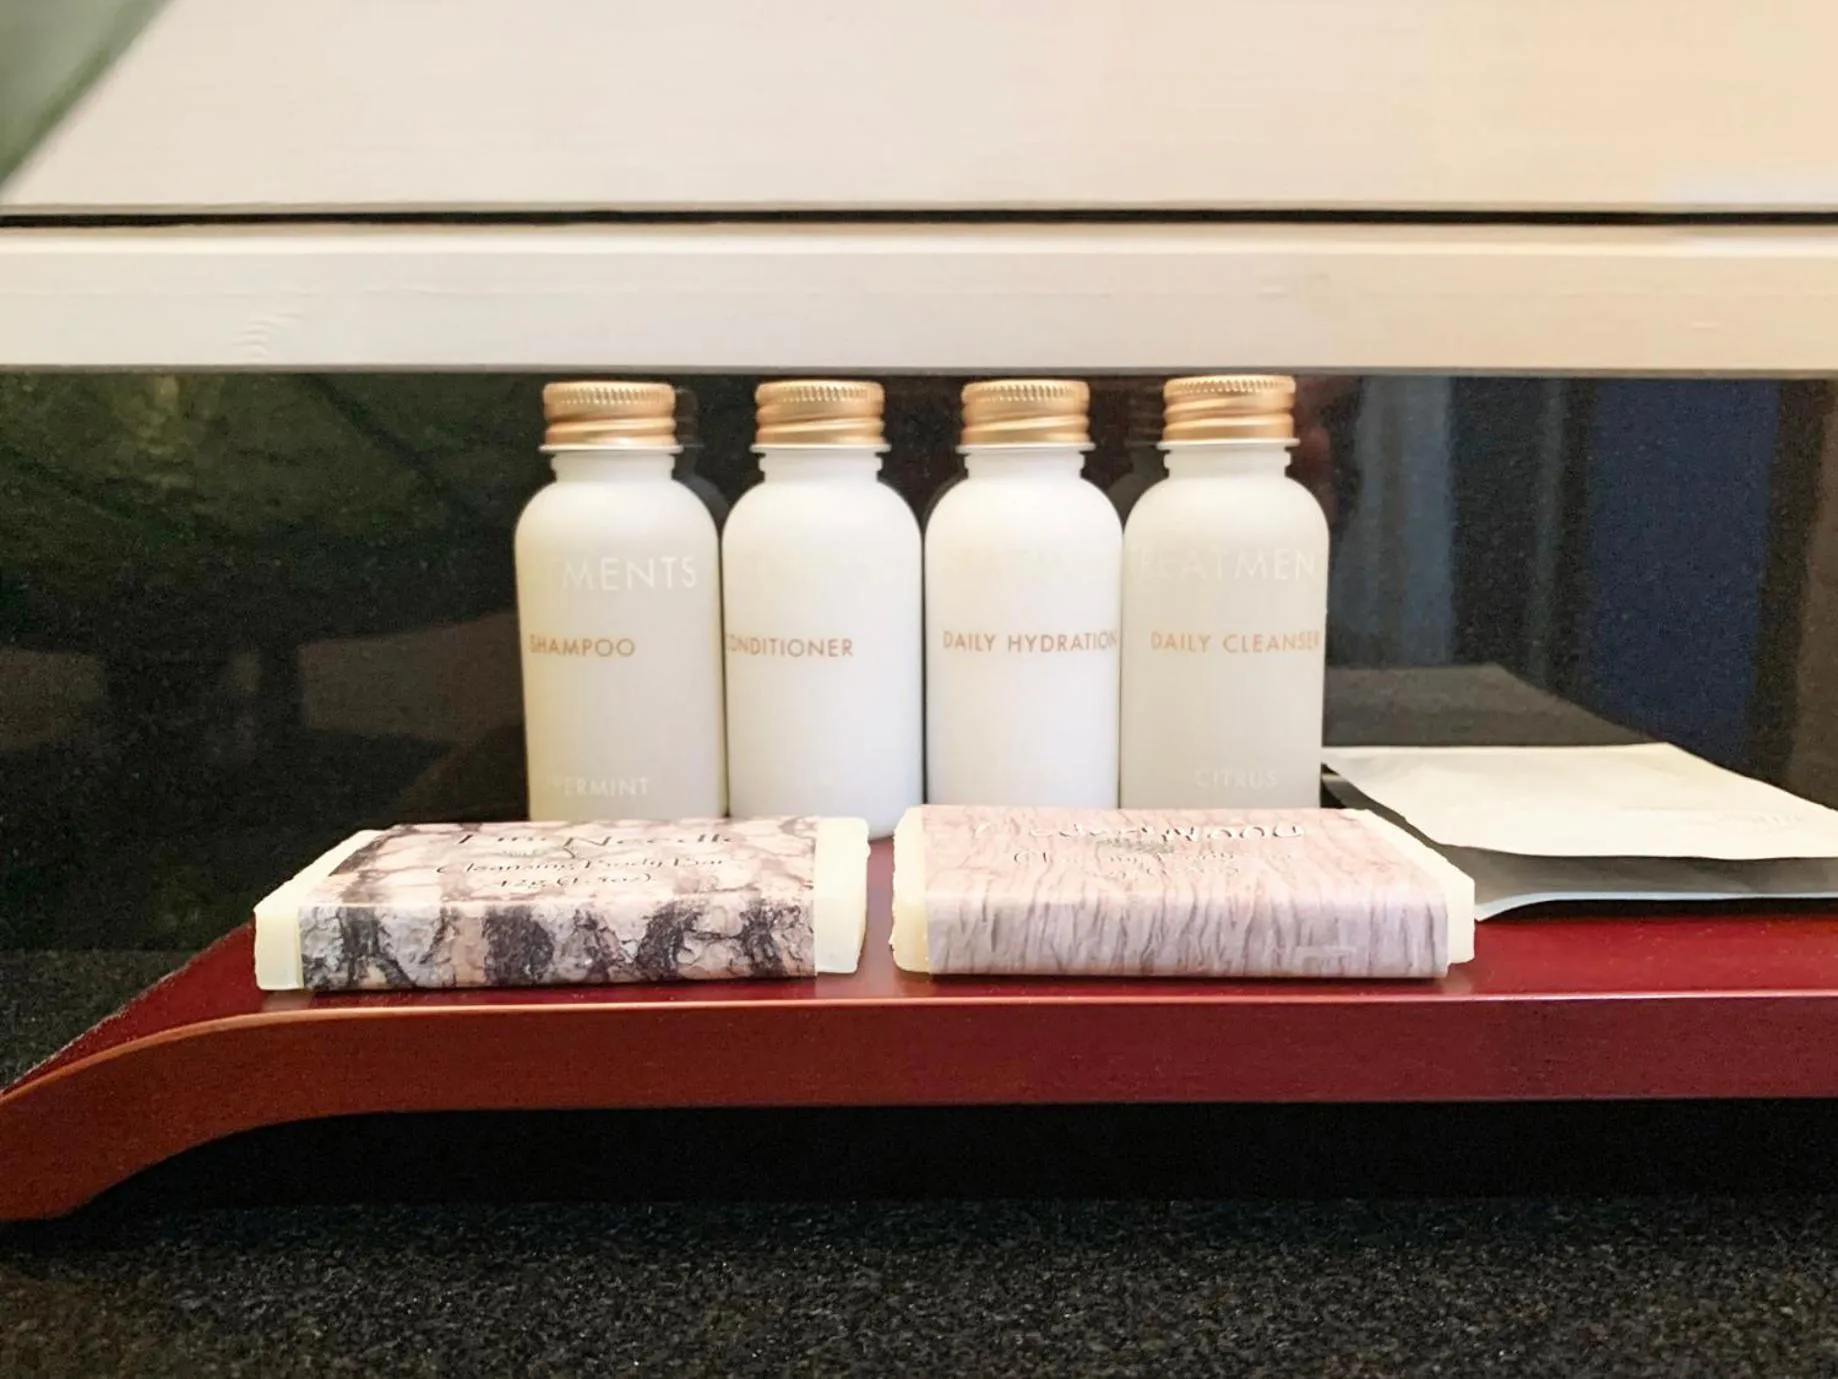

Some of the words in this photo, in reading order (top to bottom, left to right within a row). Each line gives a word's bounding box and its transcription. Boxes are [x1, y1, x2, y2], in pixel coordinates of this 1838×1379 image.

[528, 633, 637, 658] SHAMPOO
[942, 629, 996, 653] DAILY
[1150, 631, 1211, 654] DAILY
[1194, 768, 1277, 790] CITRUS
